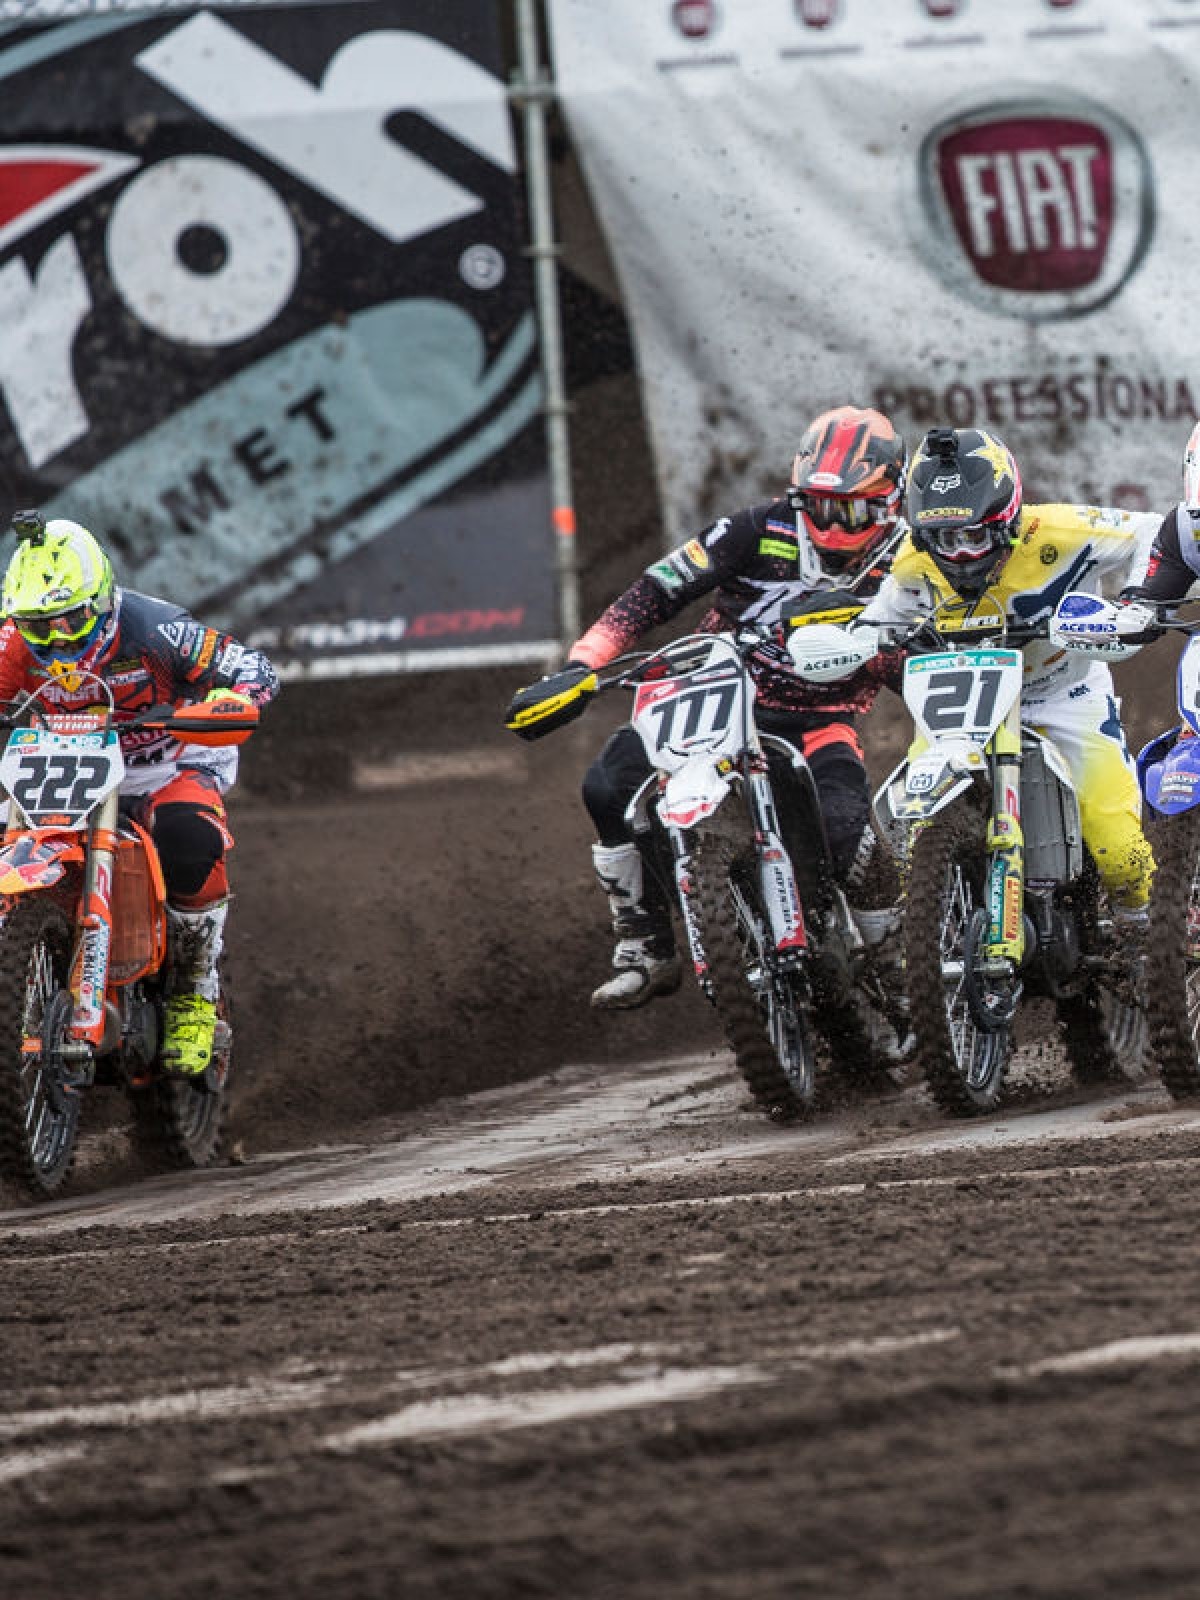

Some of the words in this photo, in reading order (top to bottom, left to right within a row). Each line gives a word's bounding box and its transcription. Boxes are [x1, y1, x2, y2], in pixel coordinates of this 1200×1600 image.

[955, 143, 1100, 258] FIAT
[1059, 623, 1117, 633] ACERBIS
[803, 653, 863, 671] ACERBIS
[651, 683, 738, 753] 777
[923, 669, 1003, 731] 21
[13, 755, 111, 811] 222
